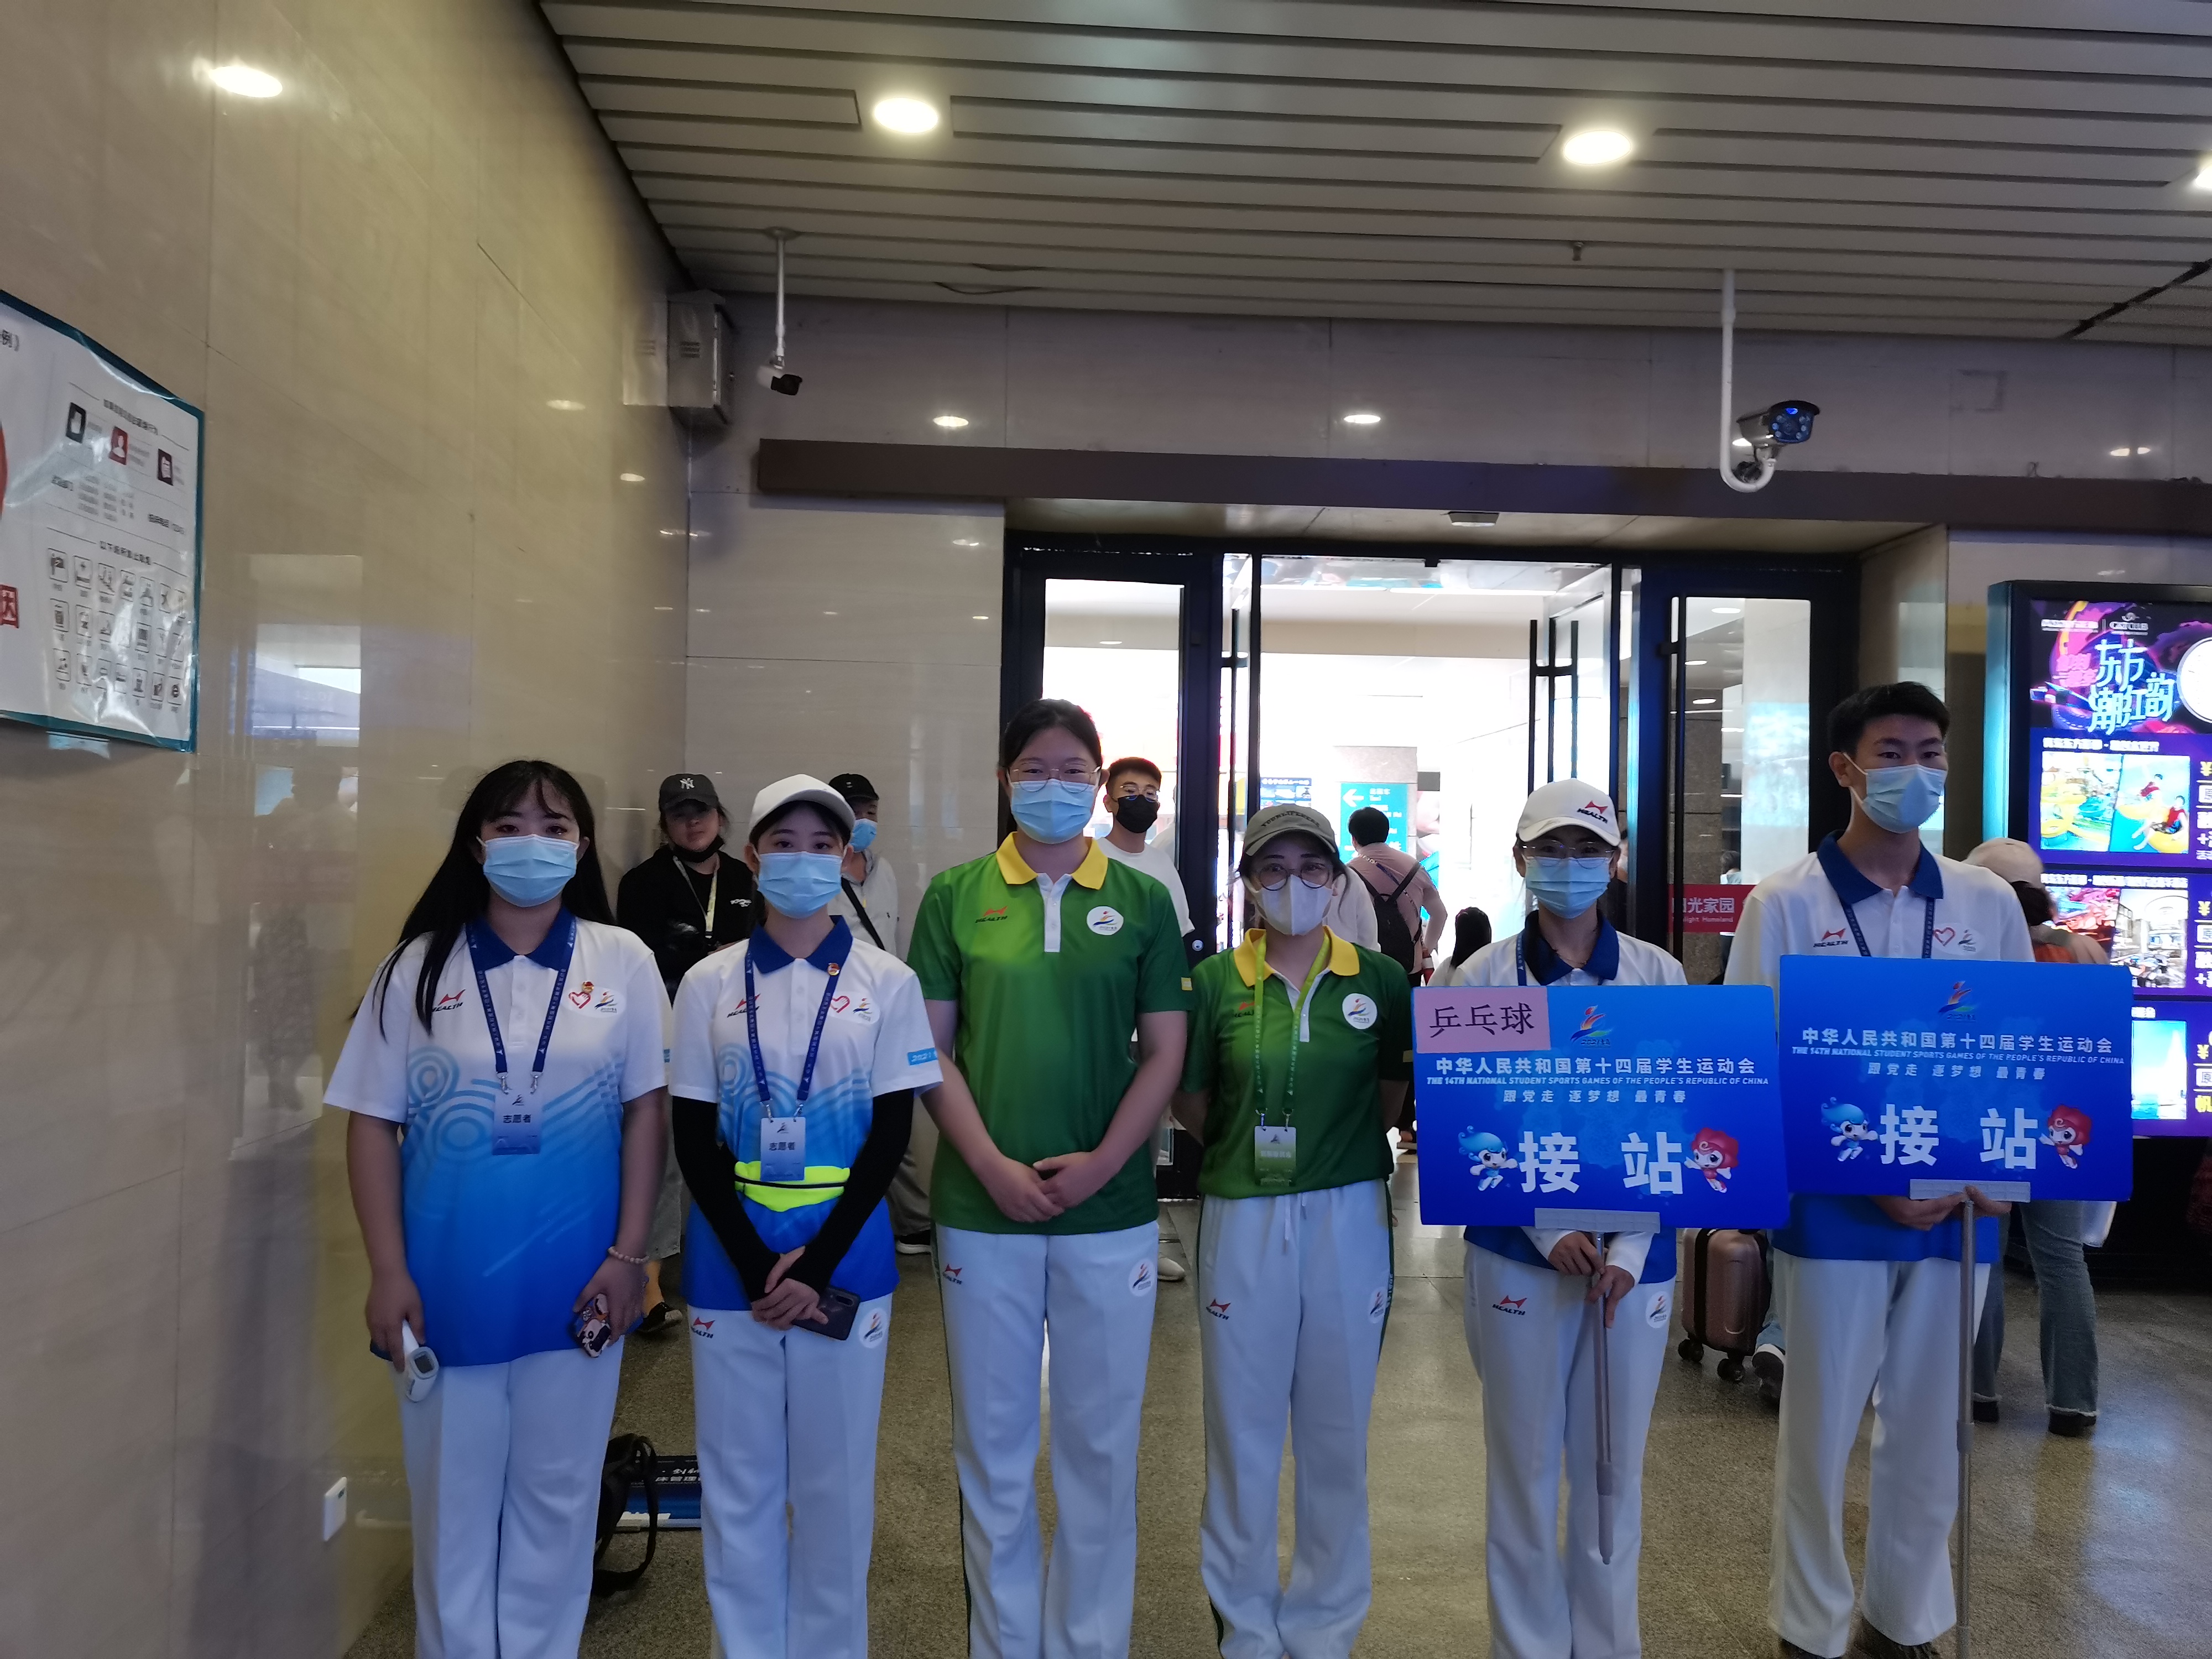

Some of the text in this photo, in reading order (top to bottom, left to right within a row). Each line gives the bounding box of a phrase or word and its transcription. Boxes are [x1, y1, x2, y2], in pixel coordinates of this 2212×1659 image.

[1577, 808, 1608, 823] HEALTH
[1813, 940, 1849, 948] HEALTH
[1429, 1002, 1535, 1038] 乒乓球
[1802, 1027, 2112, 1053] 中华人民共和国第十四届学生运动会
[1436, 1057, 1755, 1074] 中华人民共和国第十四届学生运动会
[1867, 1062, 2046, 1080] 跟党走 逐梦想 最青春
[1503, 1089, 1686, 1103] 跟党走 逐梦想 最青春
[503, 1114, 531, 1124] 志愿者
[1491, 1303, 1526, 1316] HEALTH
